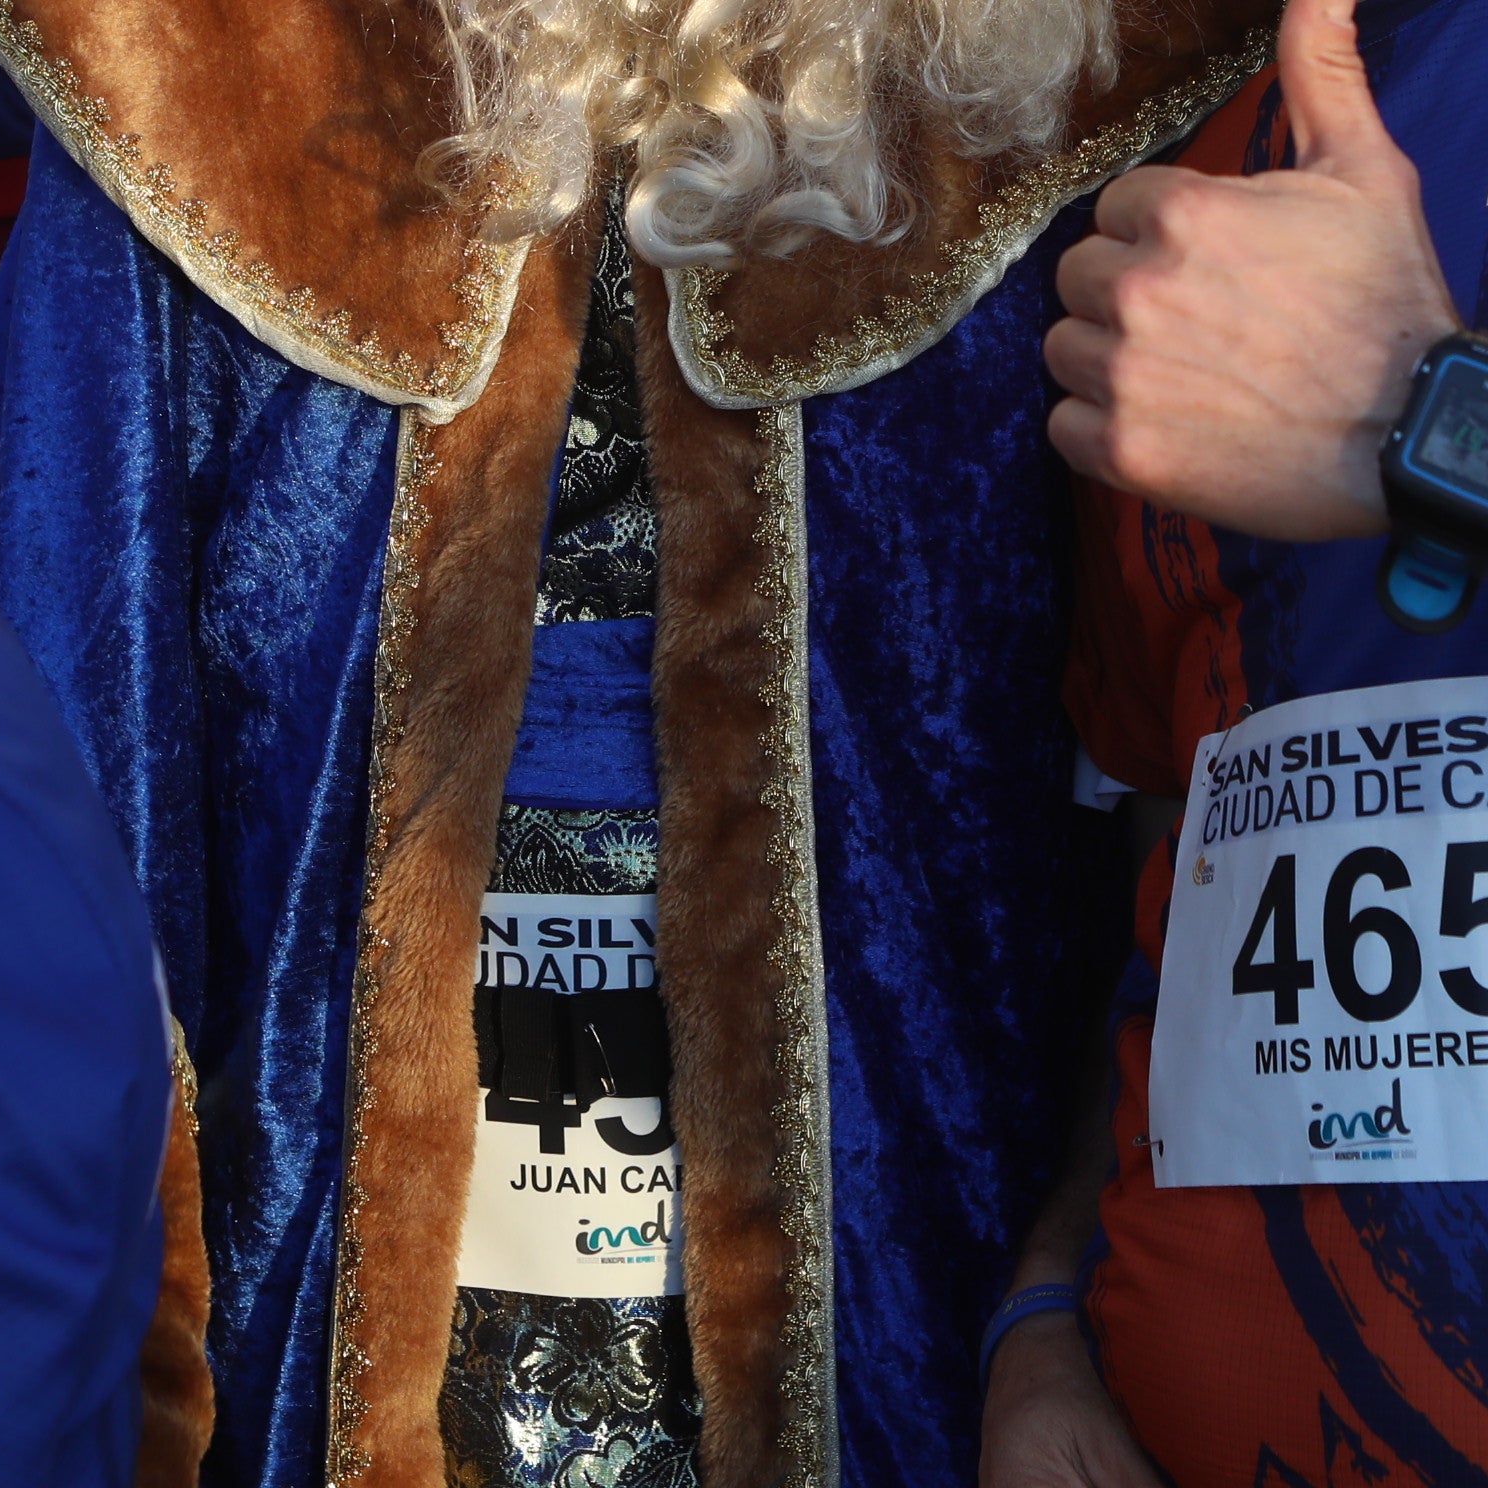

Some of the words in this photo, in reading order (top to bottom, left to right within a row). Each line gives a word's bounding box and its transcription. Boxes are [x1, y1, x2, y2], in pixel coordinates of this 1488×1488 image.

[1209, 743, 1272, 798] SAN
[1202, 773, 1336, 846] CIUDAD
[1354, 763, 1425, 819] DE
[1254, 1038, 1312, 1076] MIS
[510, 1163, 607, 1194] JUAN
